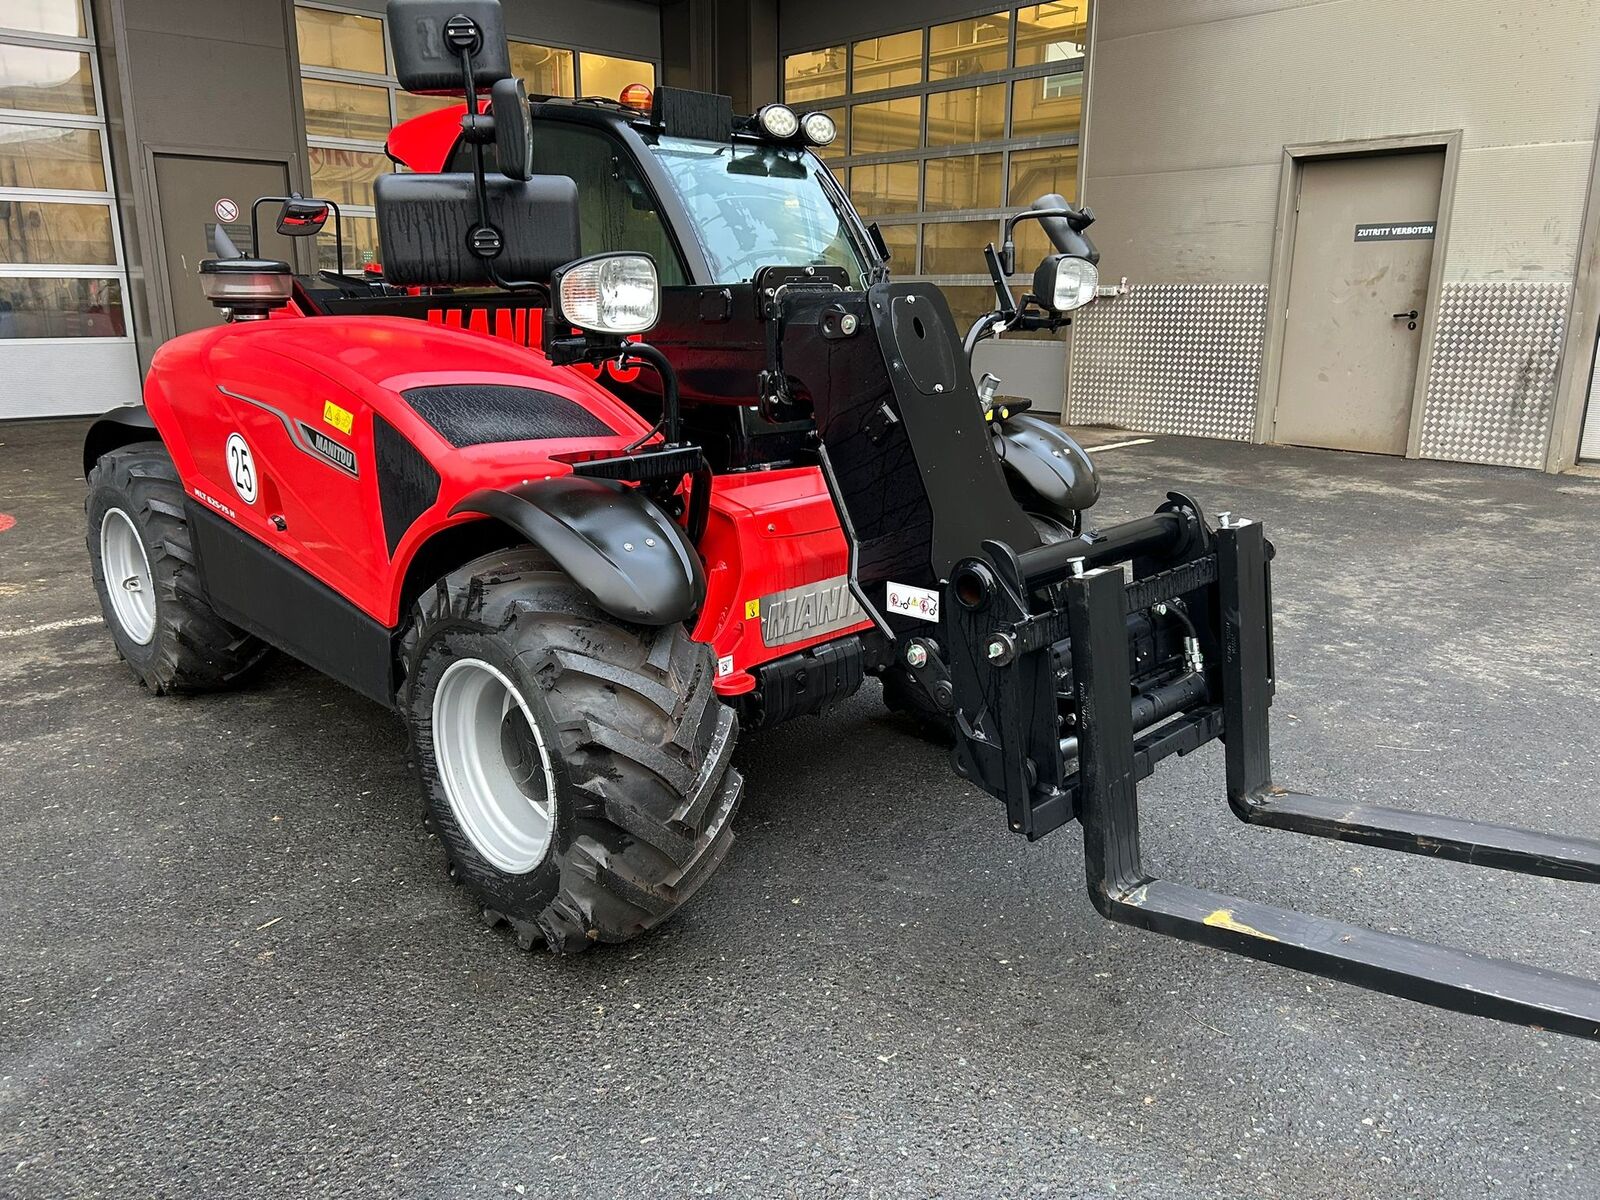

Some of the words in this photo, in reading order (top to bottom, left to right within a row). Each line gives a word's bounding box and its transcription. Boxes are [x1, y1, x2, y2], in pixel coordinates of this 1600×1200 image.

[1357, 227, 1390, 237] ZUTRITT
[1391, 226, 1434, 235] VERBOTEN
[315, 434, 354, 468] MANITOU
[231, 445, 252, 493] 25
